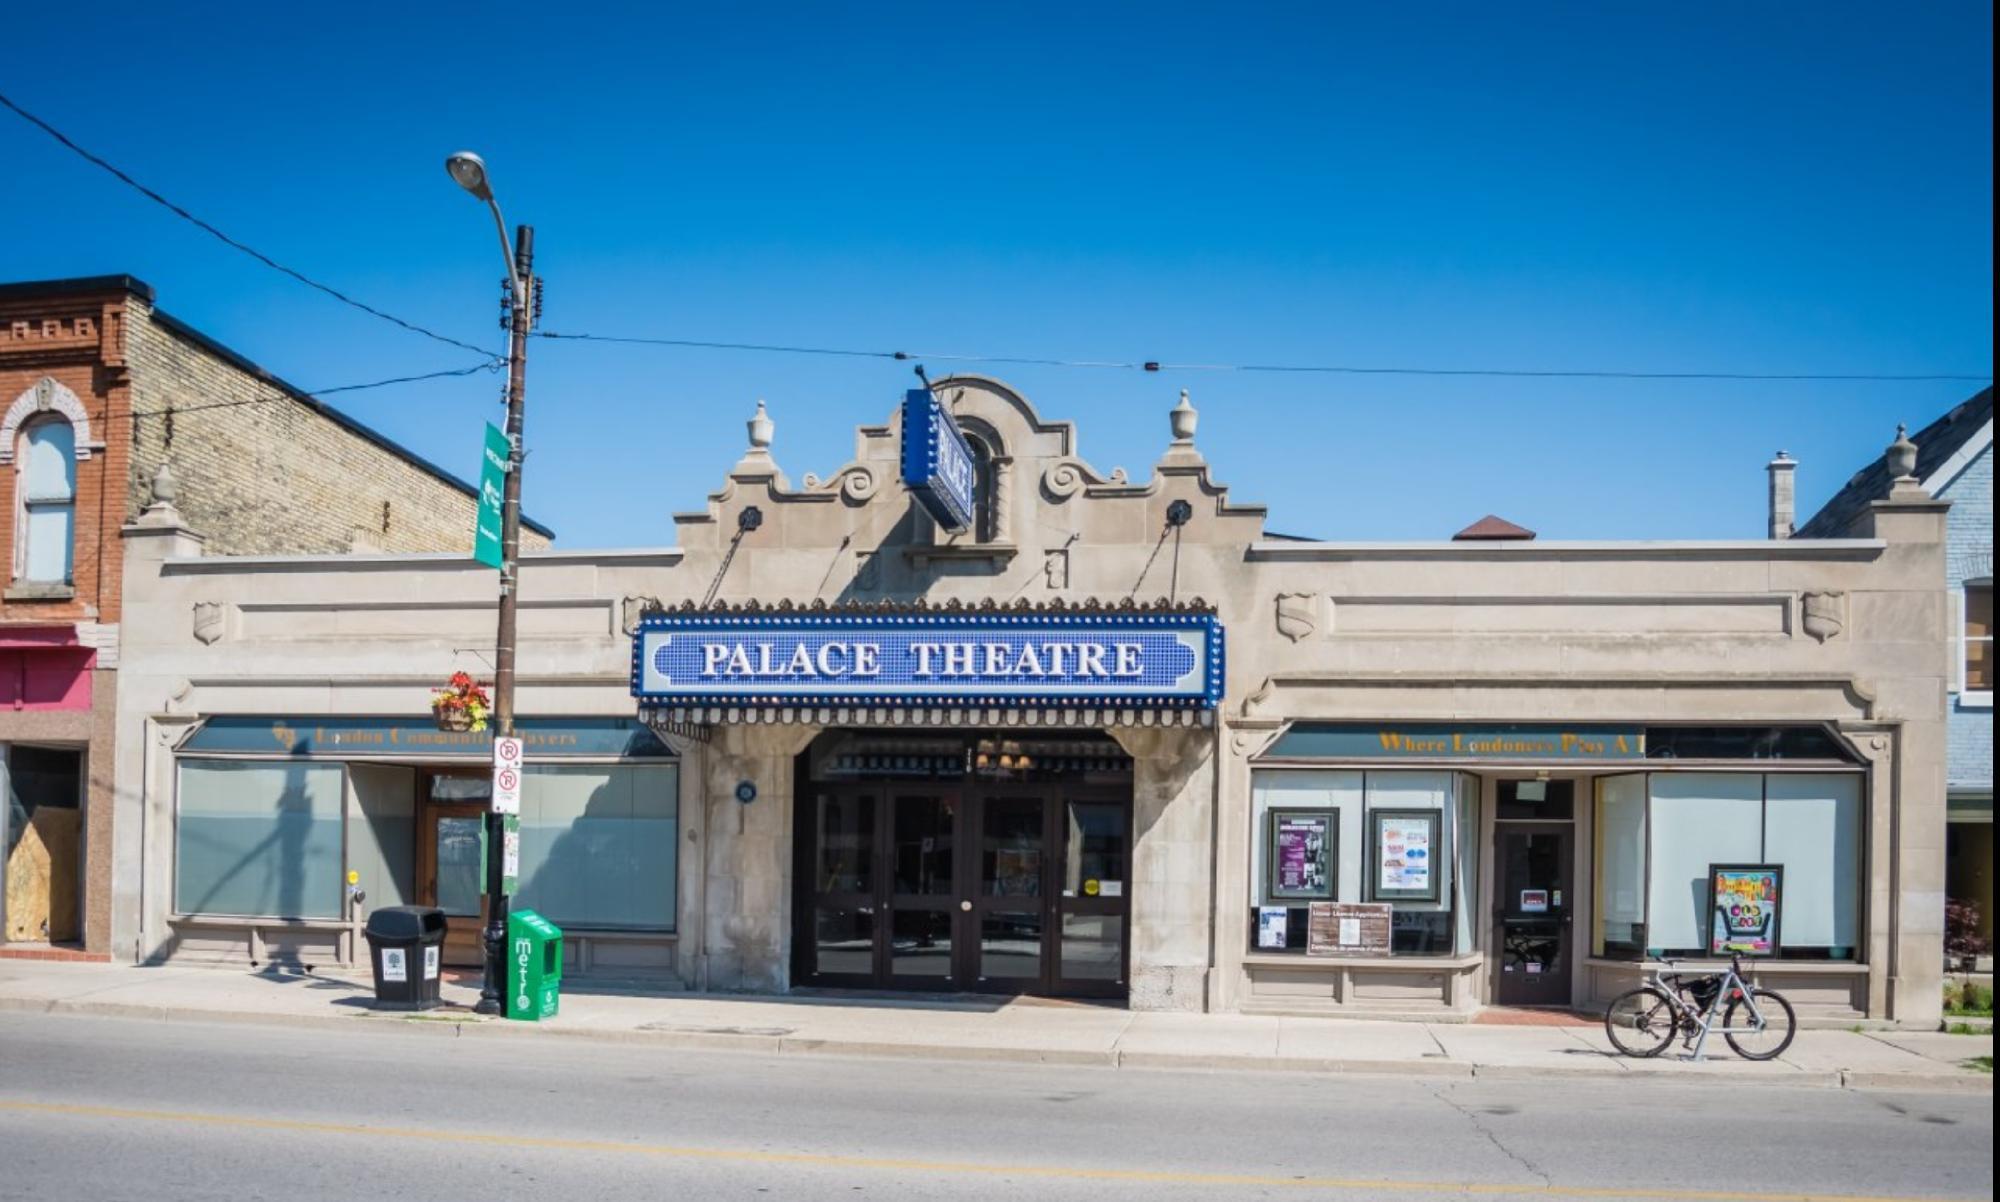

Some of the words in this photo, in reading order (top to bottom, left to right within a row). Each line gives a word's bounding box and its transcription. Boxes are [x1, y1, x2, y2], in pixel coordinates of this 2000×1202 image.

[703, 642, 880, 676] PALACE
[911, 641, 1144, 676] THEATRE
[1379, 732, 1446, 751] Where
[1453, 733, 1554, 752] Londoners
[1614, 734, 1629, 752] A
[516, 938, 531, 1010] metro
